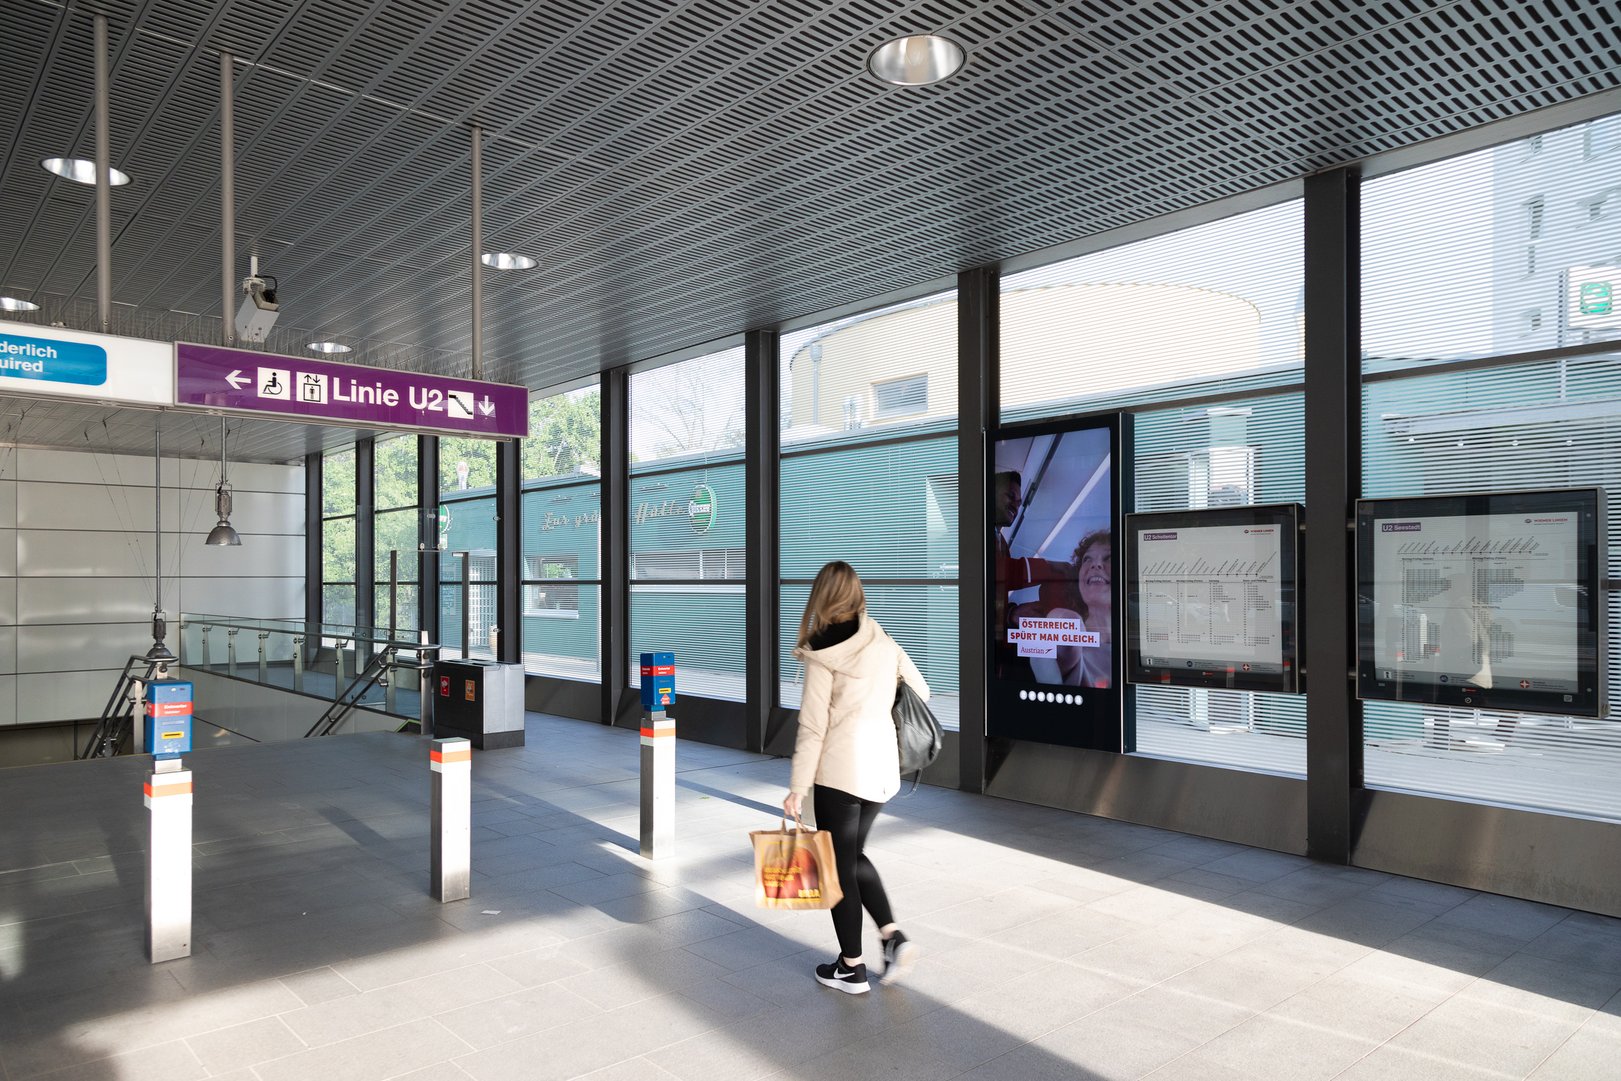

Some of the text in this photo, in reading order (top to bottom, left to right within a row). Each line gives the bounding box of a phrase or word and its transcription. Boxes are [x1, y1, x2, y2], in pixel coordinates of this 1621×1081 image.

[333, 377, 444, 411] Linie U2
[1022, 618, 1078, 630] ÖSTERREICH.
[1010, 630, 1097, 643] SPÜRT MAN GLEICH.
[1021, 647, 1045, 655] Austrian
